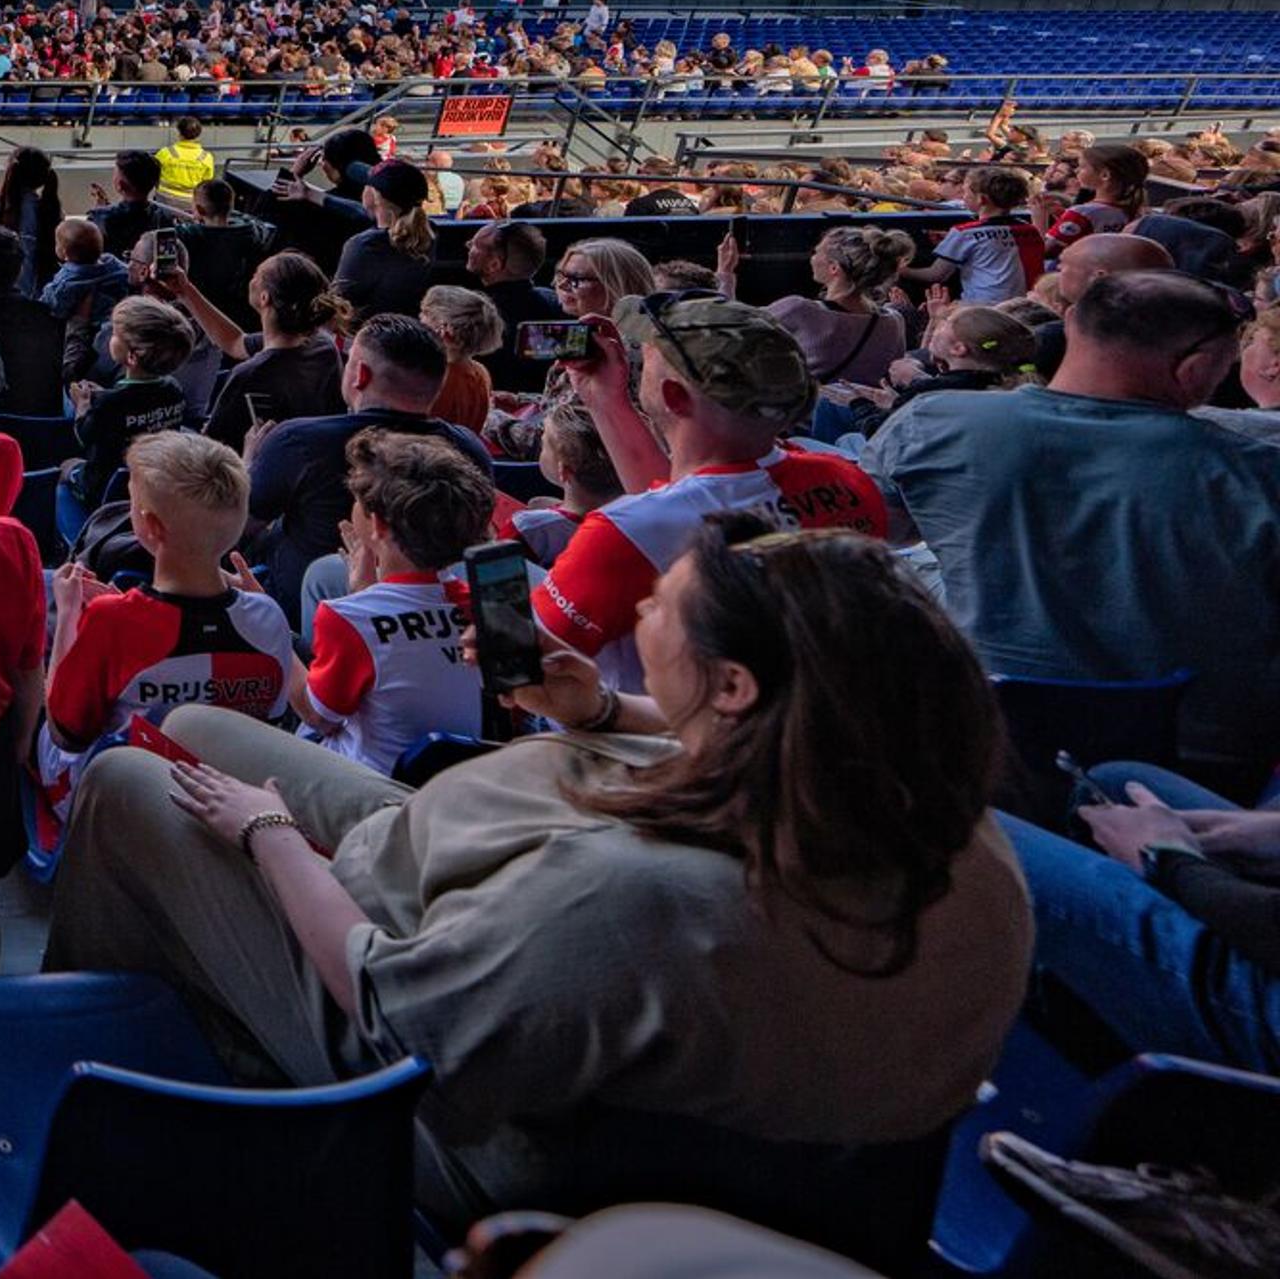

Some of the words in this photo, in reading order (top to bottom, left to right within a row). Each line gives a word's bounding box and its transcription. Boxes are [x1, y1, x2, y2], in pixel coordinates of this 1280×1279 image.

[446, 98, 461, 111] DE
[462, 97, 494, 111] KUIP
[493, 97, 507, 110] IS
